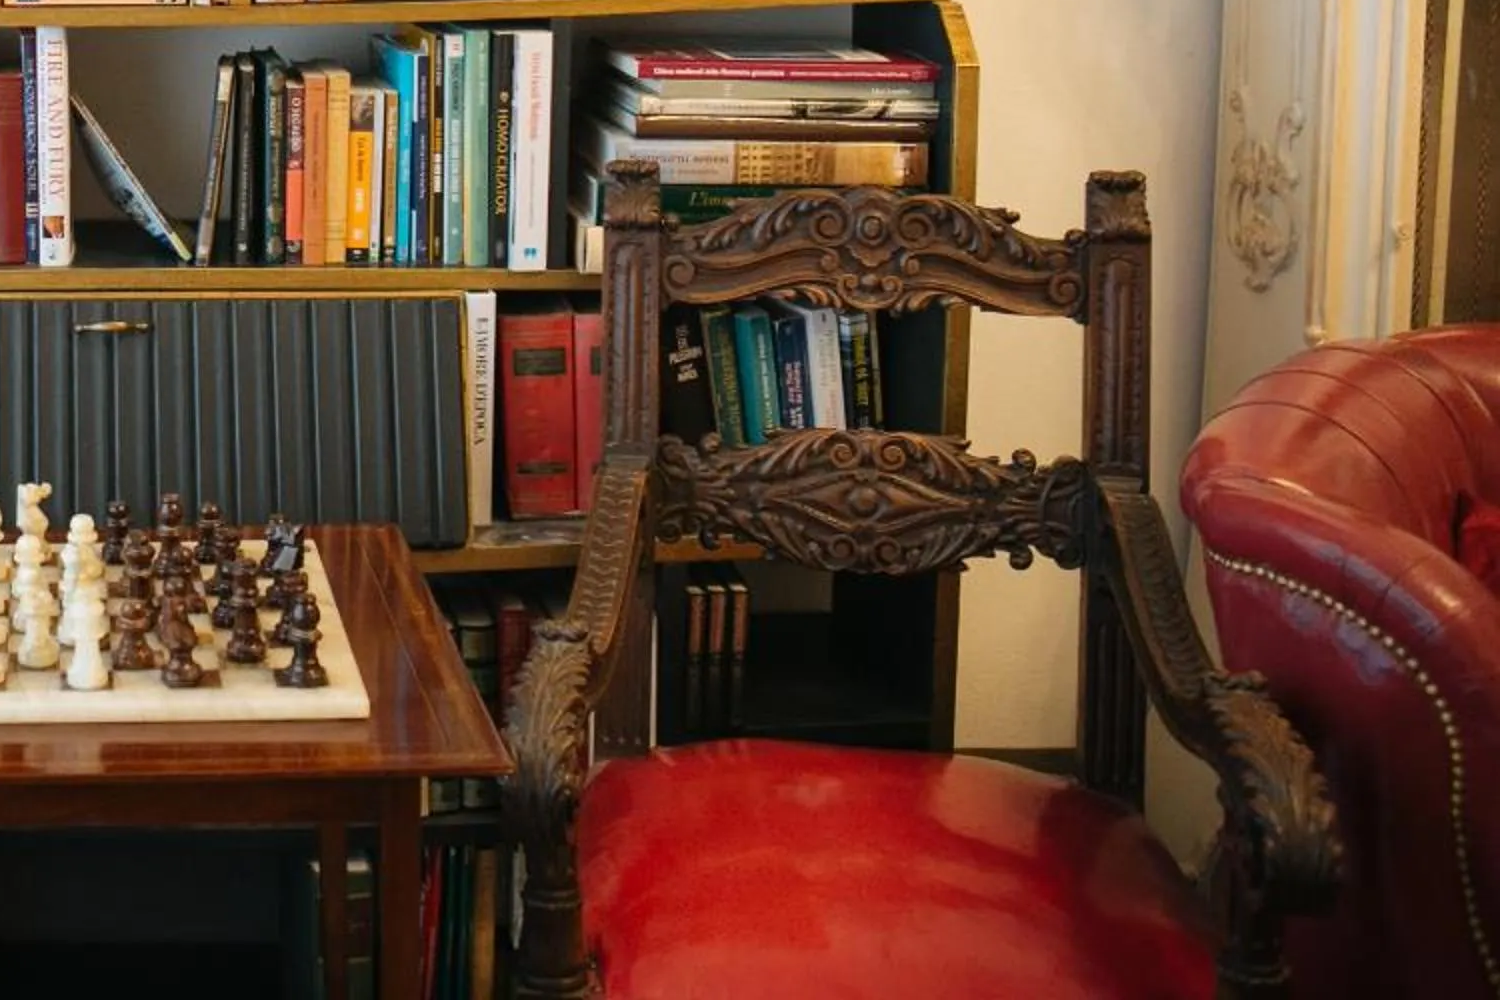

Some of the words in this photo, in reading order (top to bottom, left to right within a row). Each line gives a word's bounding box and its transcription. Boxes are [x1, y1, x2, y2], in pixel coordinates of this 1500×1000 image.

[48, 39, 63, 83] FIRE
[48, 97, 64, 140] AND
[497, 109, 510, 152] HOMO
[48, 147, 65, 199] FURY
[495, 156, 509, 215] CREATOR
